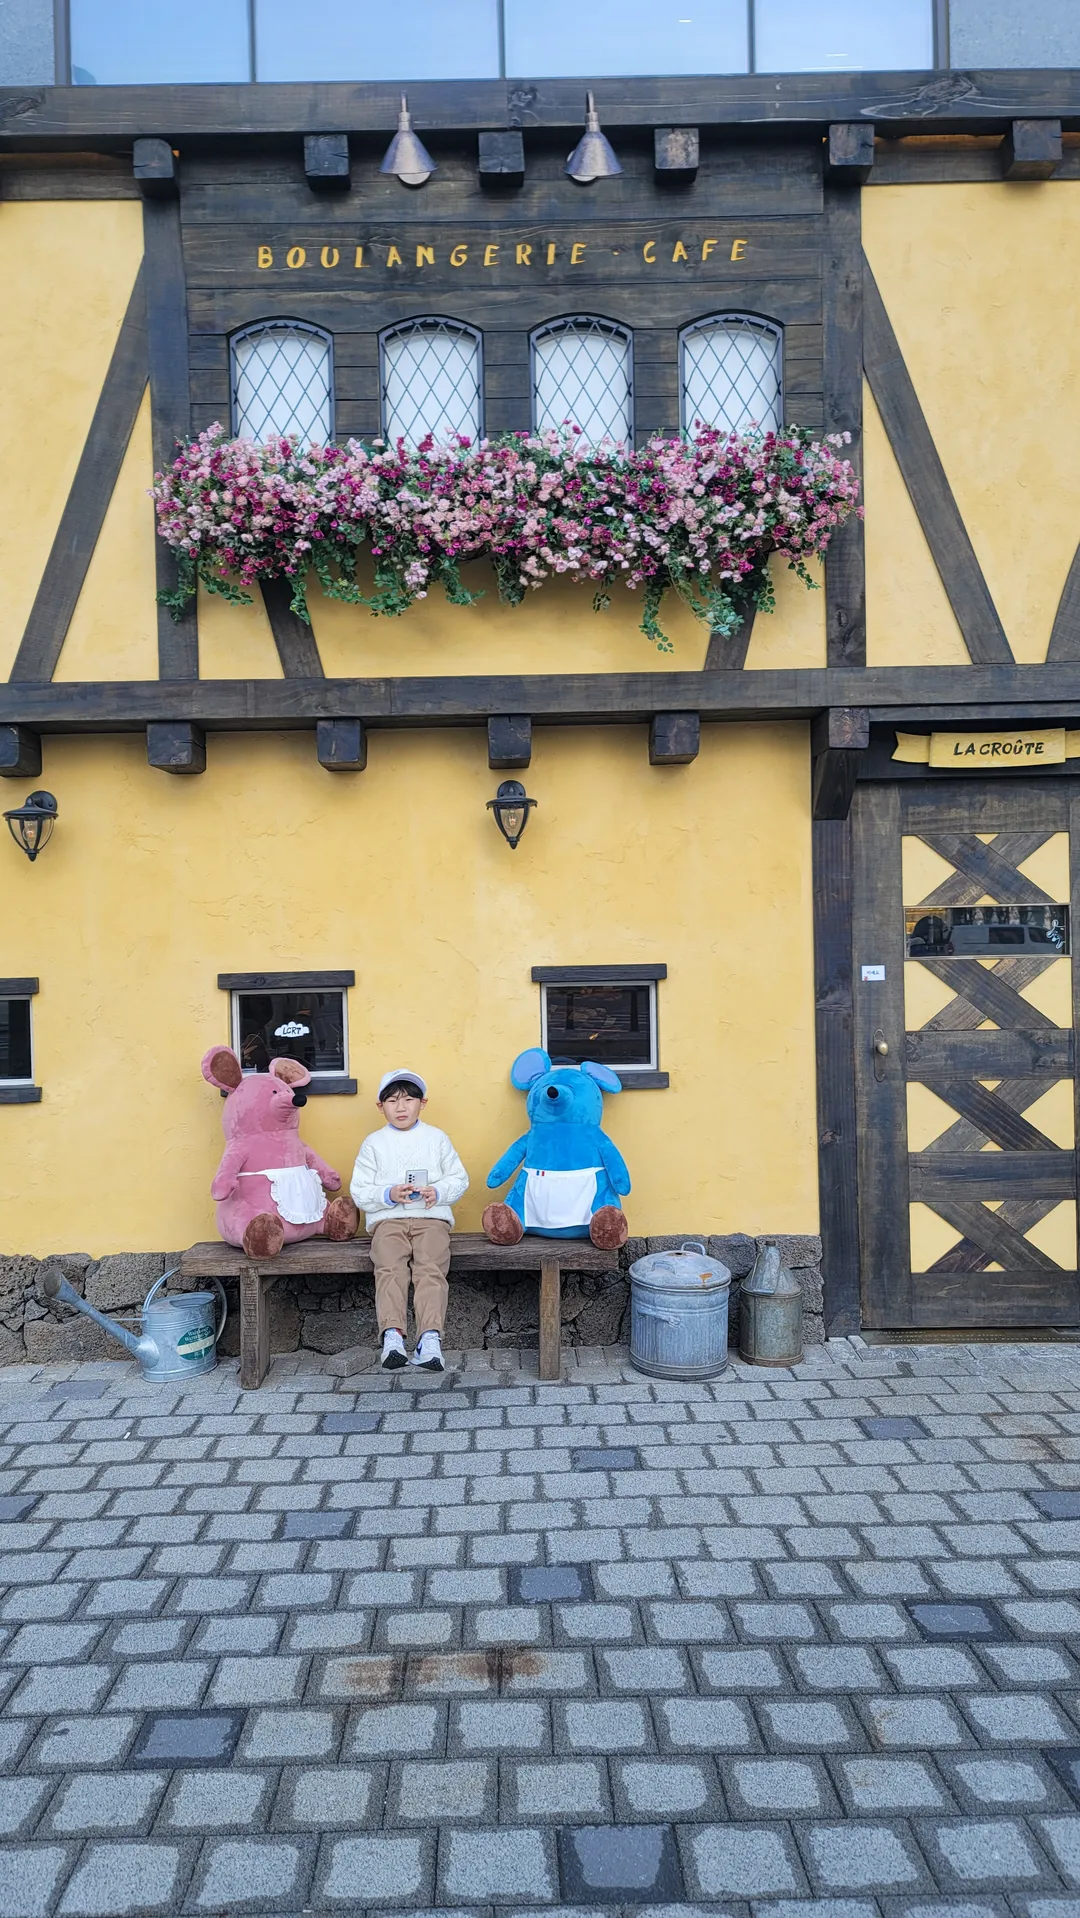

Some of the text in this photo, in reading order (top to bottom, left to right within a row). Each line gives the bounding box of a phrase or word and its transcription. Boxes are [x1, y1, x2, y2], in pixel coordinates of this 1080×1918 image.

[257, 239, 748, 269] BOULANGERIE CAFE
[953, 739, 1045, 757] LA CROÛTE
[282, 1026, 302, 1035] LCRT
